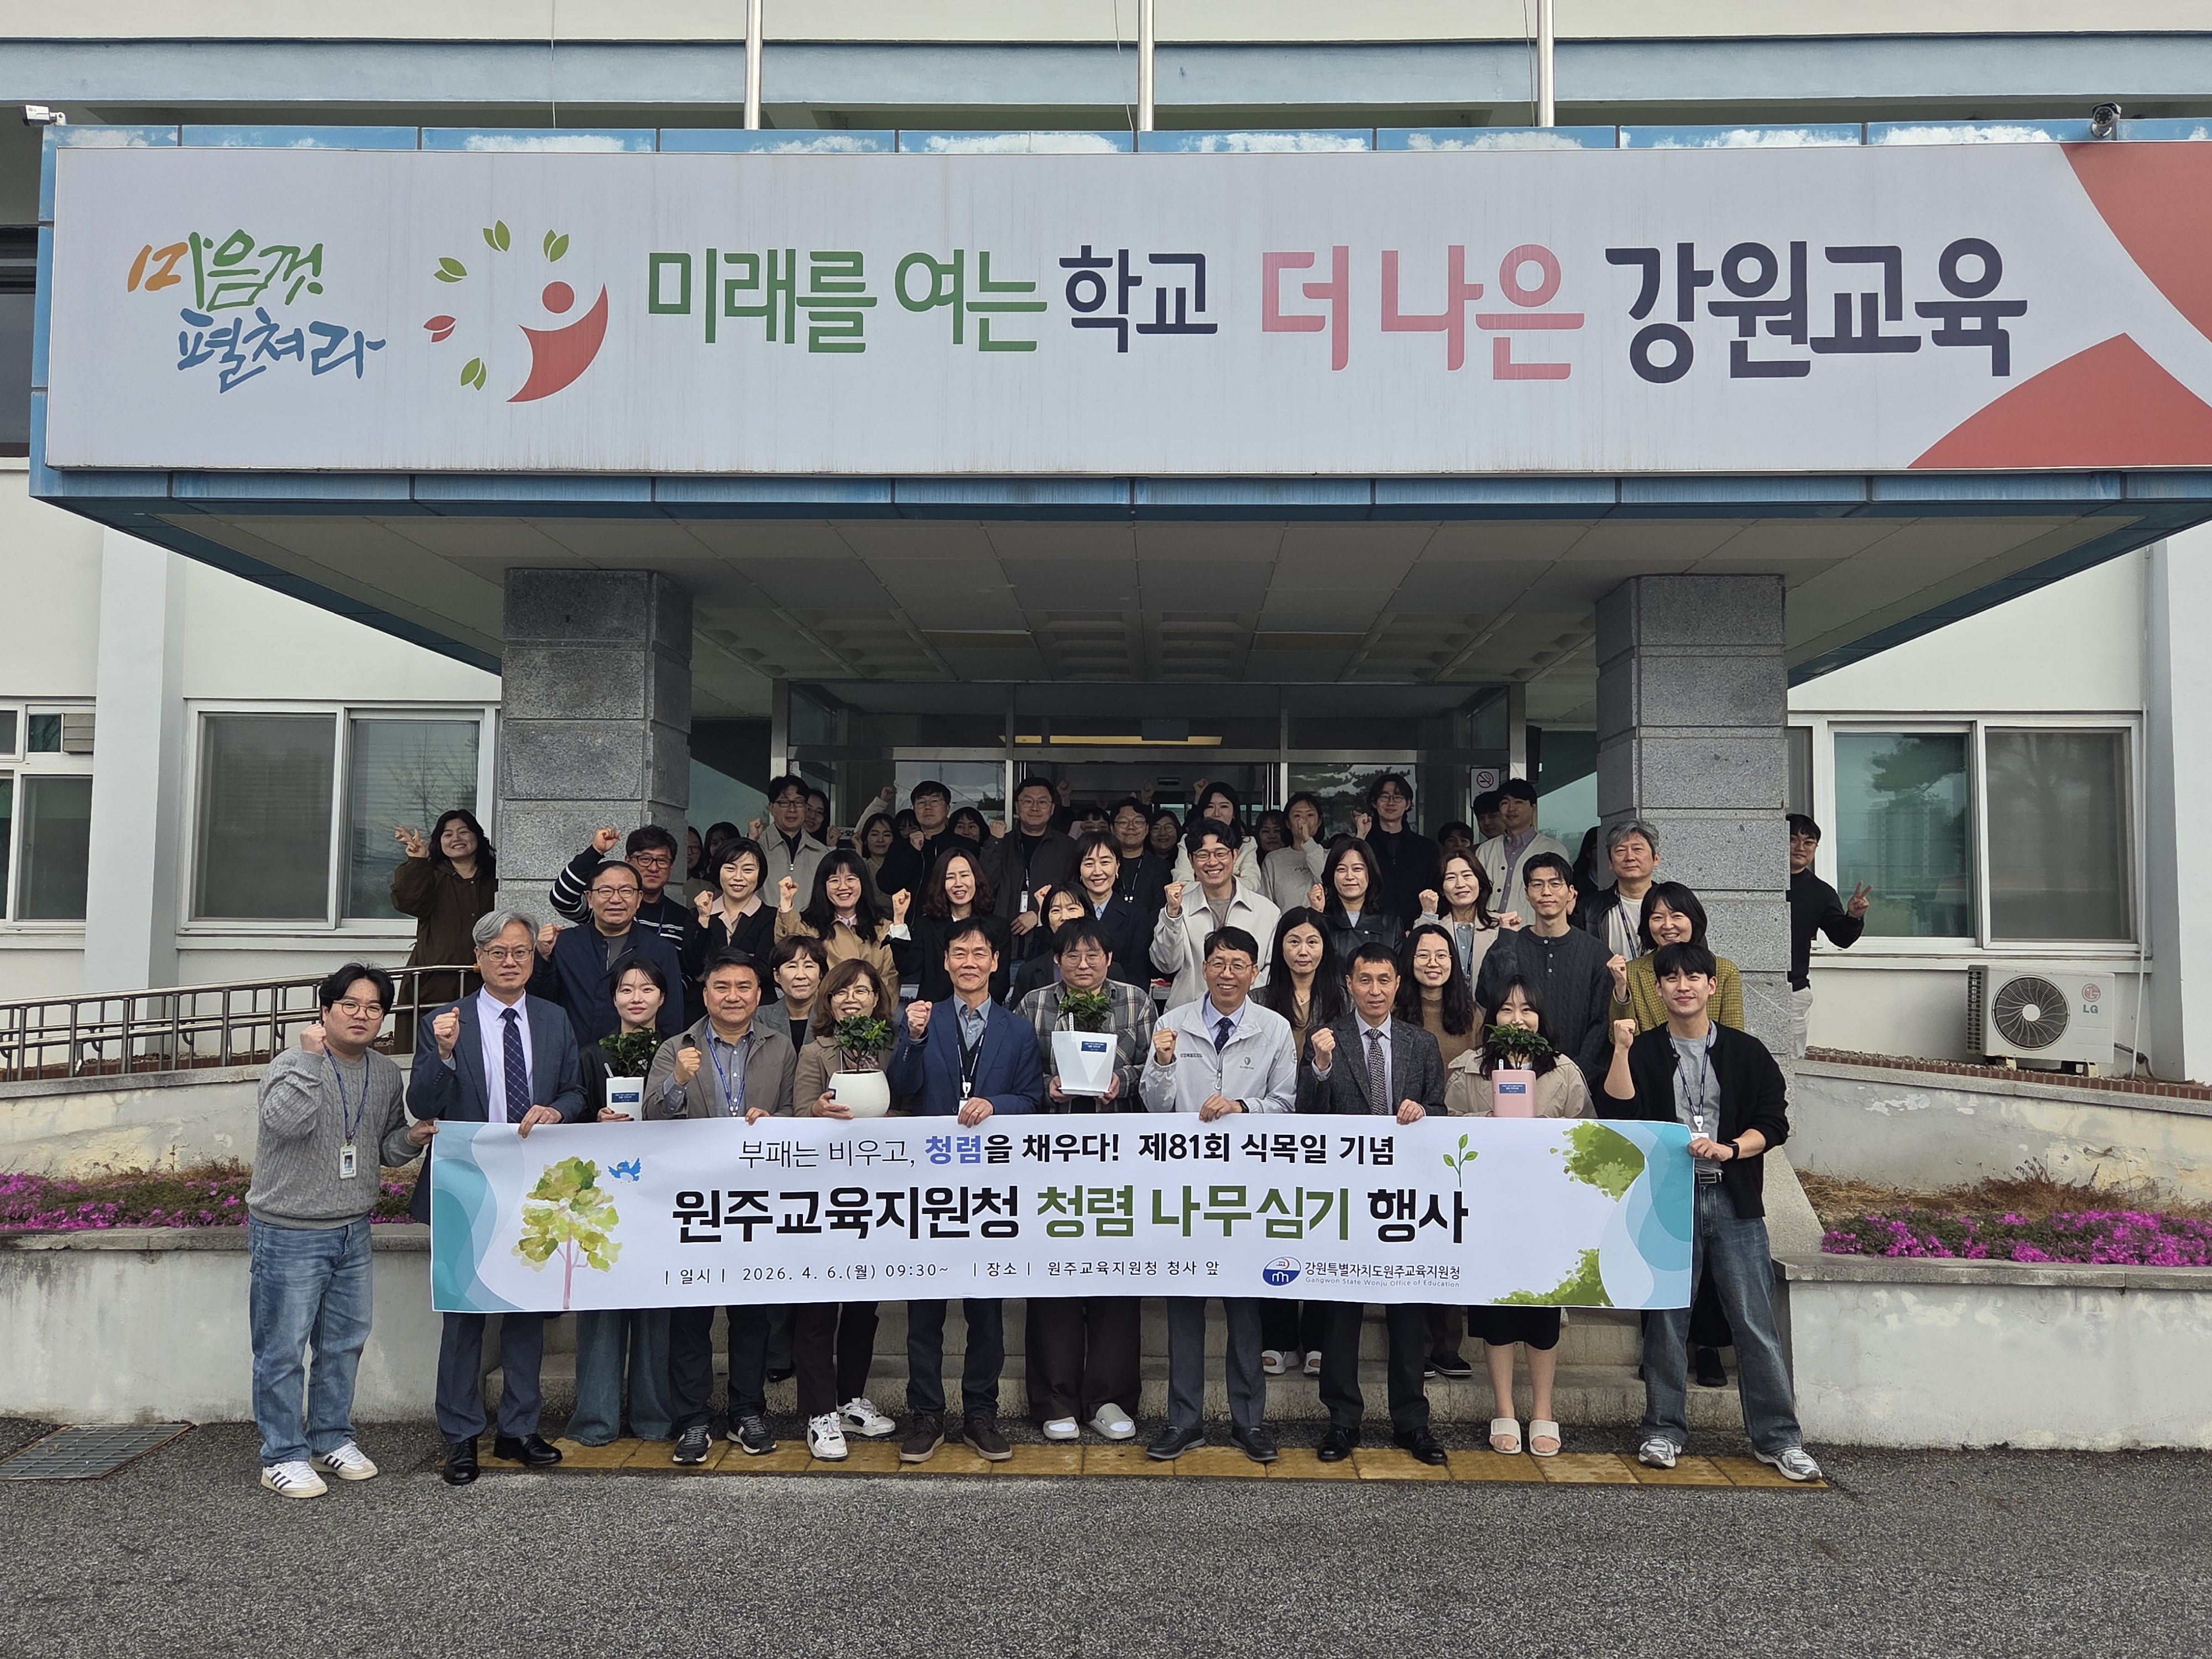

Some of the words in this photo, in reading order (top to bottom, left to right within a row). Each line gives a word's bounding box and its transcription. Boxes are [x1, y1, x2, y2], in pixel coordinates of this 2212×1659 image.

[127, 228, 324, 313] 마음껏
[649, 248, 878, 354] 미래를
[894, 250, 1048, 353] 여는
[1058, 244, 1218, 354] 학교
[1261, 245, 1349, 371] 더
[1381, 244, 1585, 380] 나은
[1605, 237, 2028, 383] 강원교육
[177, 306, 387, 394] 펼쳐라
[2083, 1004, 2098, 1014] LG
[738, 1140, 820, 1169] 부패는
[829, 1139, 915, 1168] 비우고,
[925, 1134, 1013, 1165] 청렴을
[1021, 1133, 1119, 1164] 채우다!
[1138, 1132, 1230, 1163] 제81회
[1240, 1134, 1327, 1165] 식목일
[1339, 1135, 1394, 1166] 기념
[672, 1185, 1019, 1244] 원주교육지원청
[1037, 1185, 1134, 1238] 청렴
[1151, 1186, 1349, 1241] 나무심기
[1368, 1188, 1469, 1244] 행사
[680, 1268, 710, 1285] 일시
[743, 1267, 792, 1281] 2026.
[802, 1266, 817, 1280] 4.
[827, 1264, 875, 1280] 6.(월)
[885, 1264, 948, 1278] 09:30~
[987, 1261, 1017, 1277] 장소
[1047, 1261, 1157, 1276] 원주교육지원청
[1167, 1260, 1197, 1276] 청사
[1206, 1261, 1220, 1276] 앞
[1305, 1261, 1460, 1280] 강원특별자치도원주교육지원청
[1305, 1276, 1340, 1285] Gangwon
